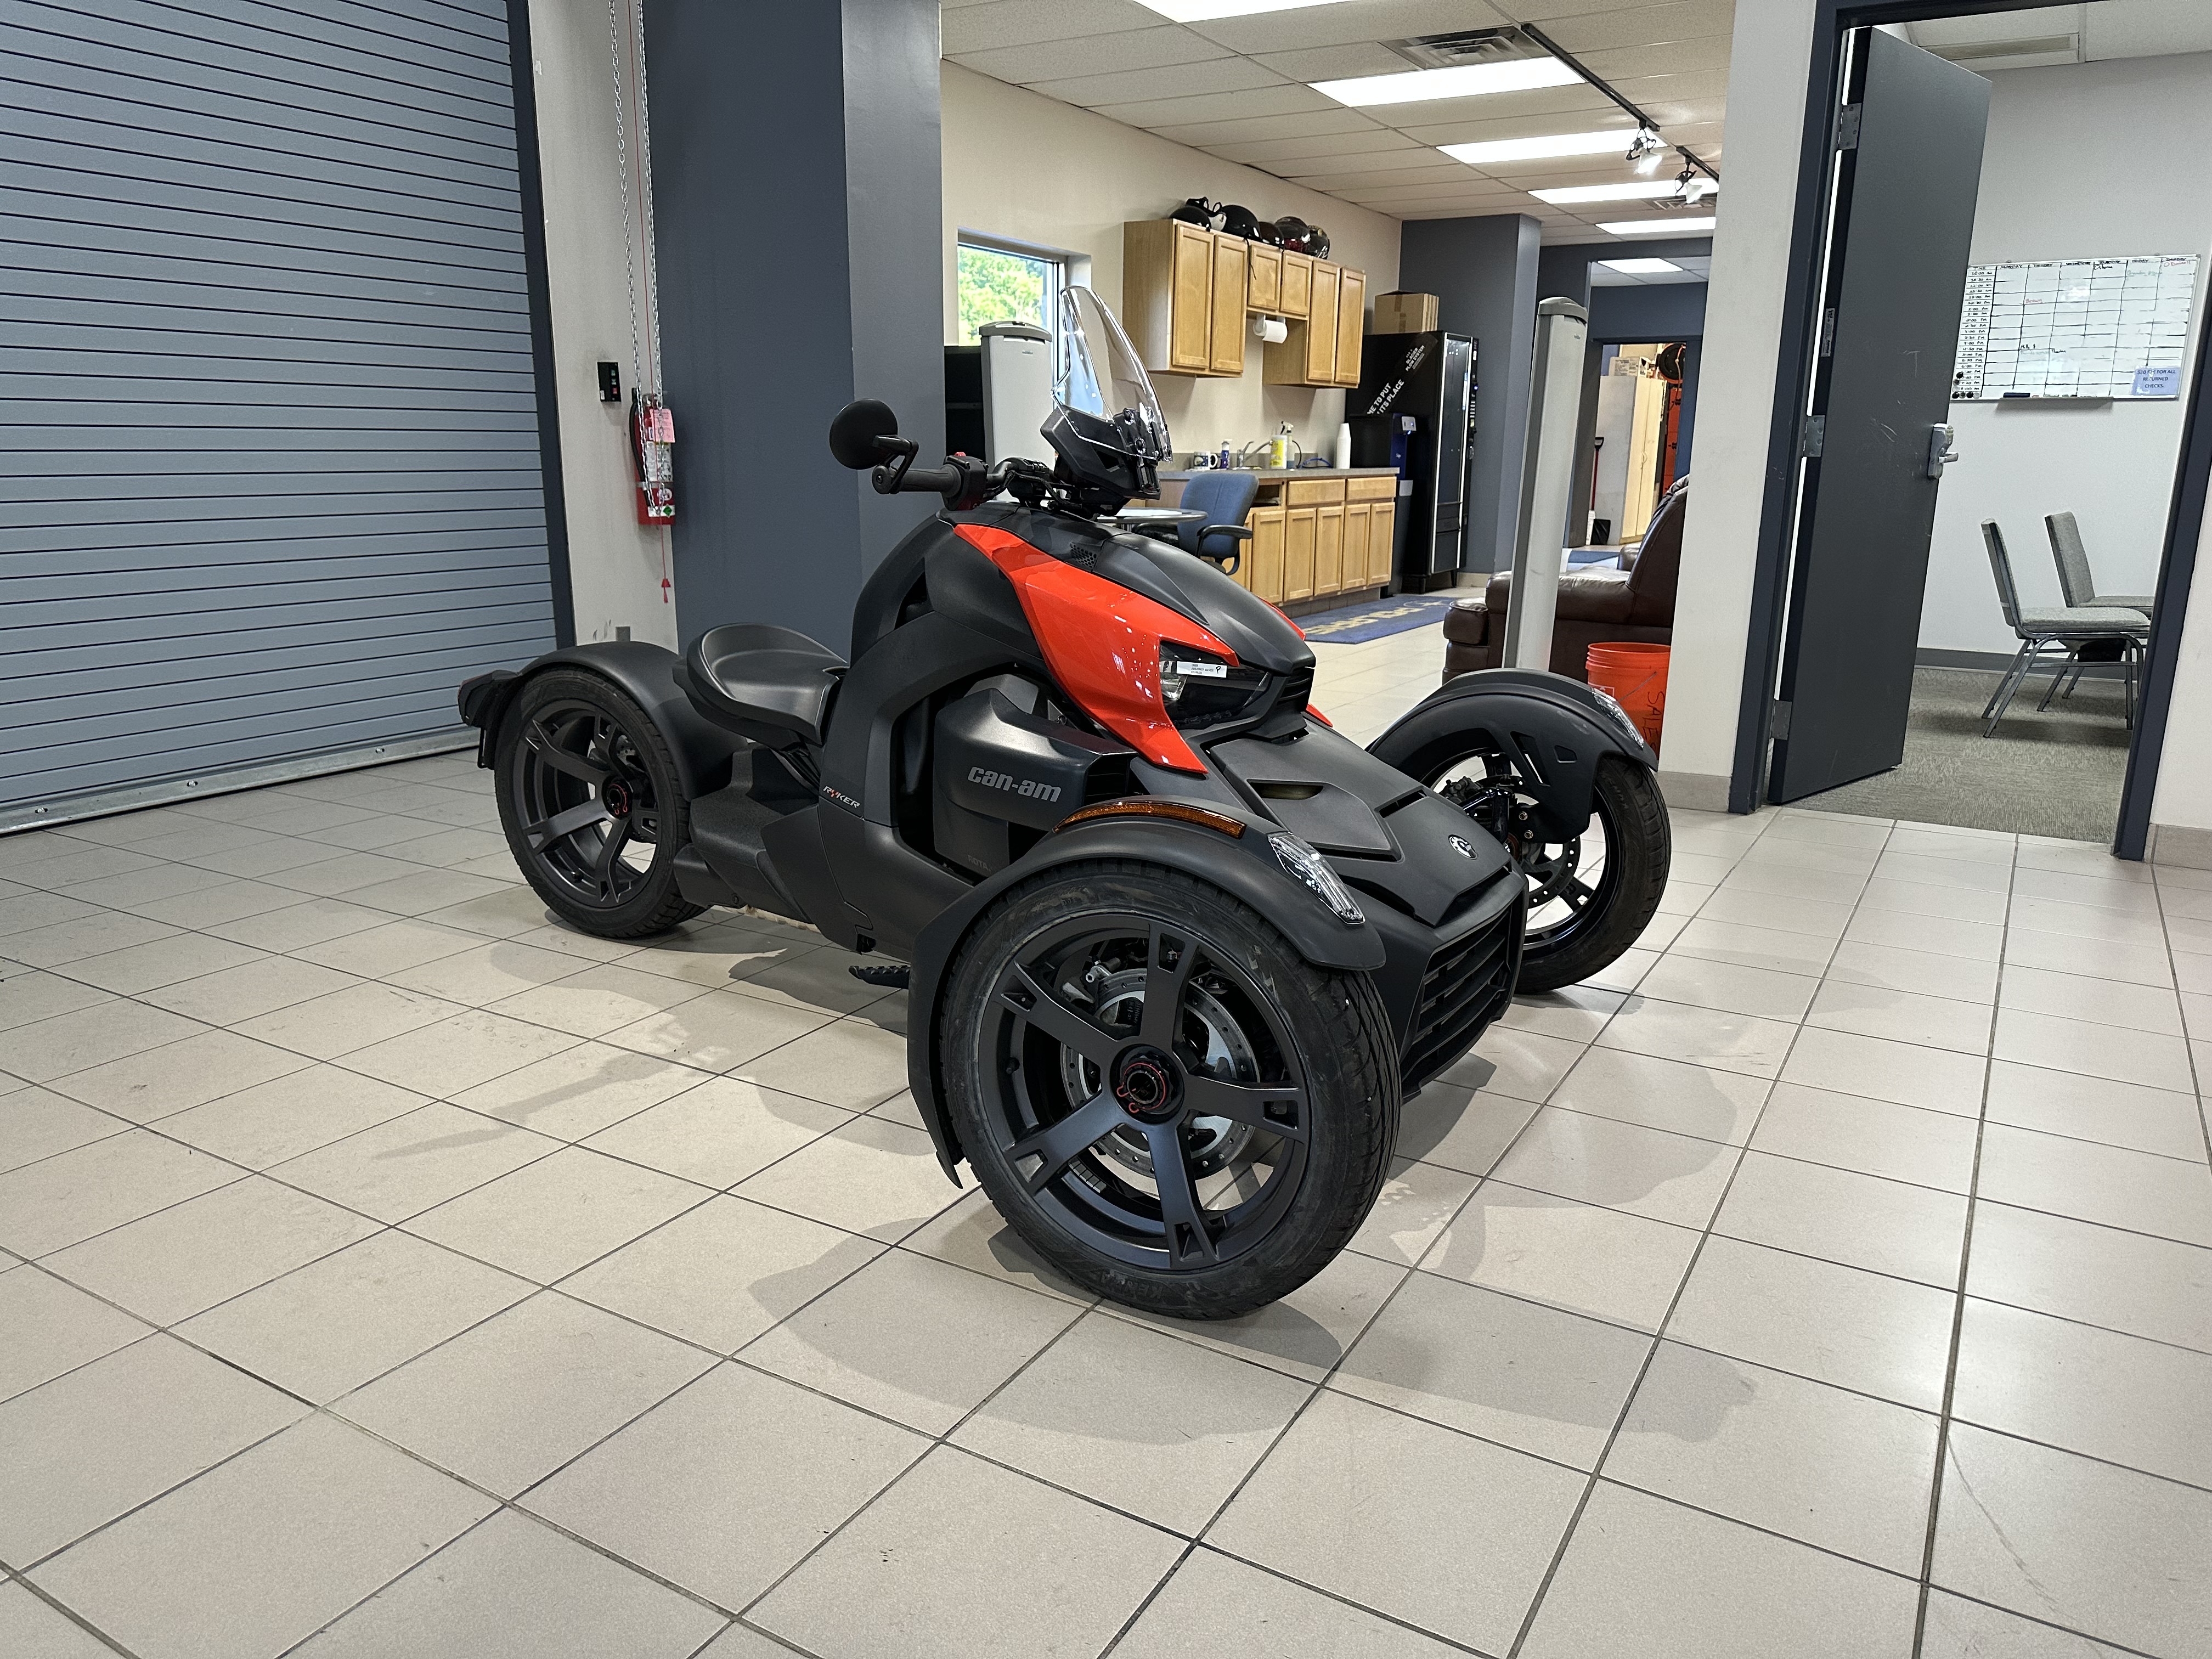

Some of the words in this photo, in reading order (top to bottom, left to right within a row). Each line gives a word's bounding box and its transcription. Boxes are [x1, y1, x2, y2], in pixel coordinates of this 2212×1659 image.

[1373, 396, 1383, 406] TO
[1380, 382, 1391, 398] PUT
[1379, 400, 1389, 413] ITS
[1386, 379, 1404, 402] PLACE
[823, 786, 860, 808] RYKER
[967, 766, 1062, 803] can-am
